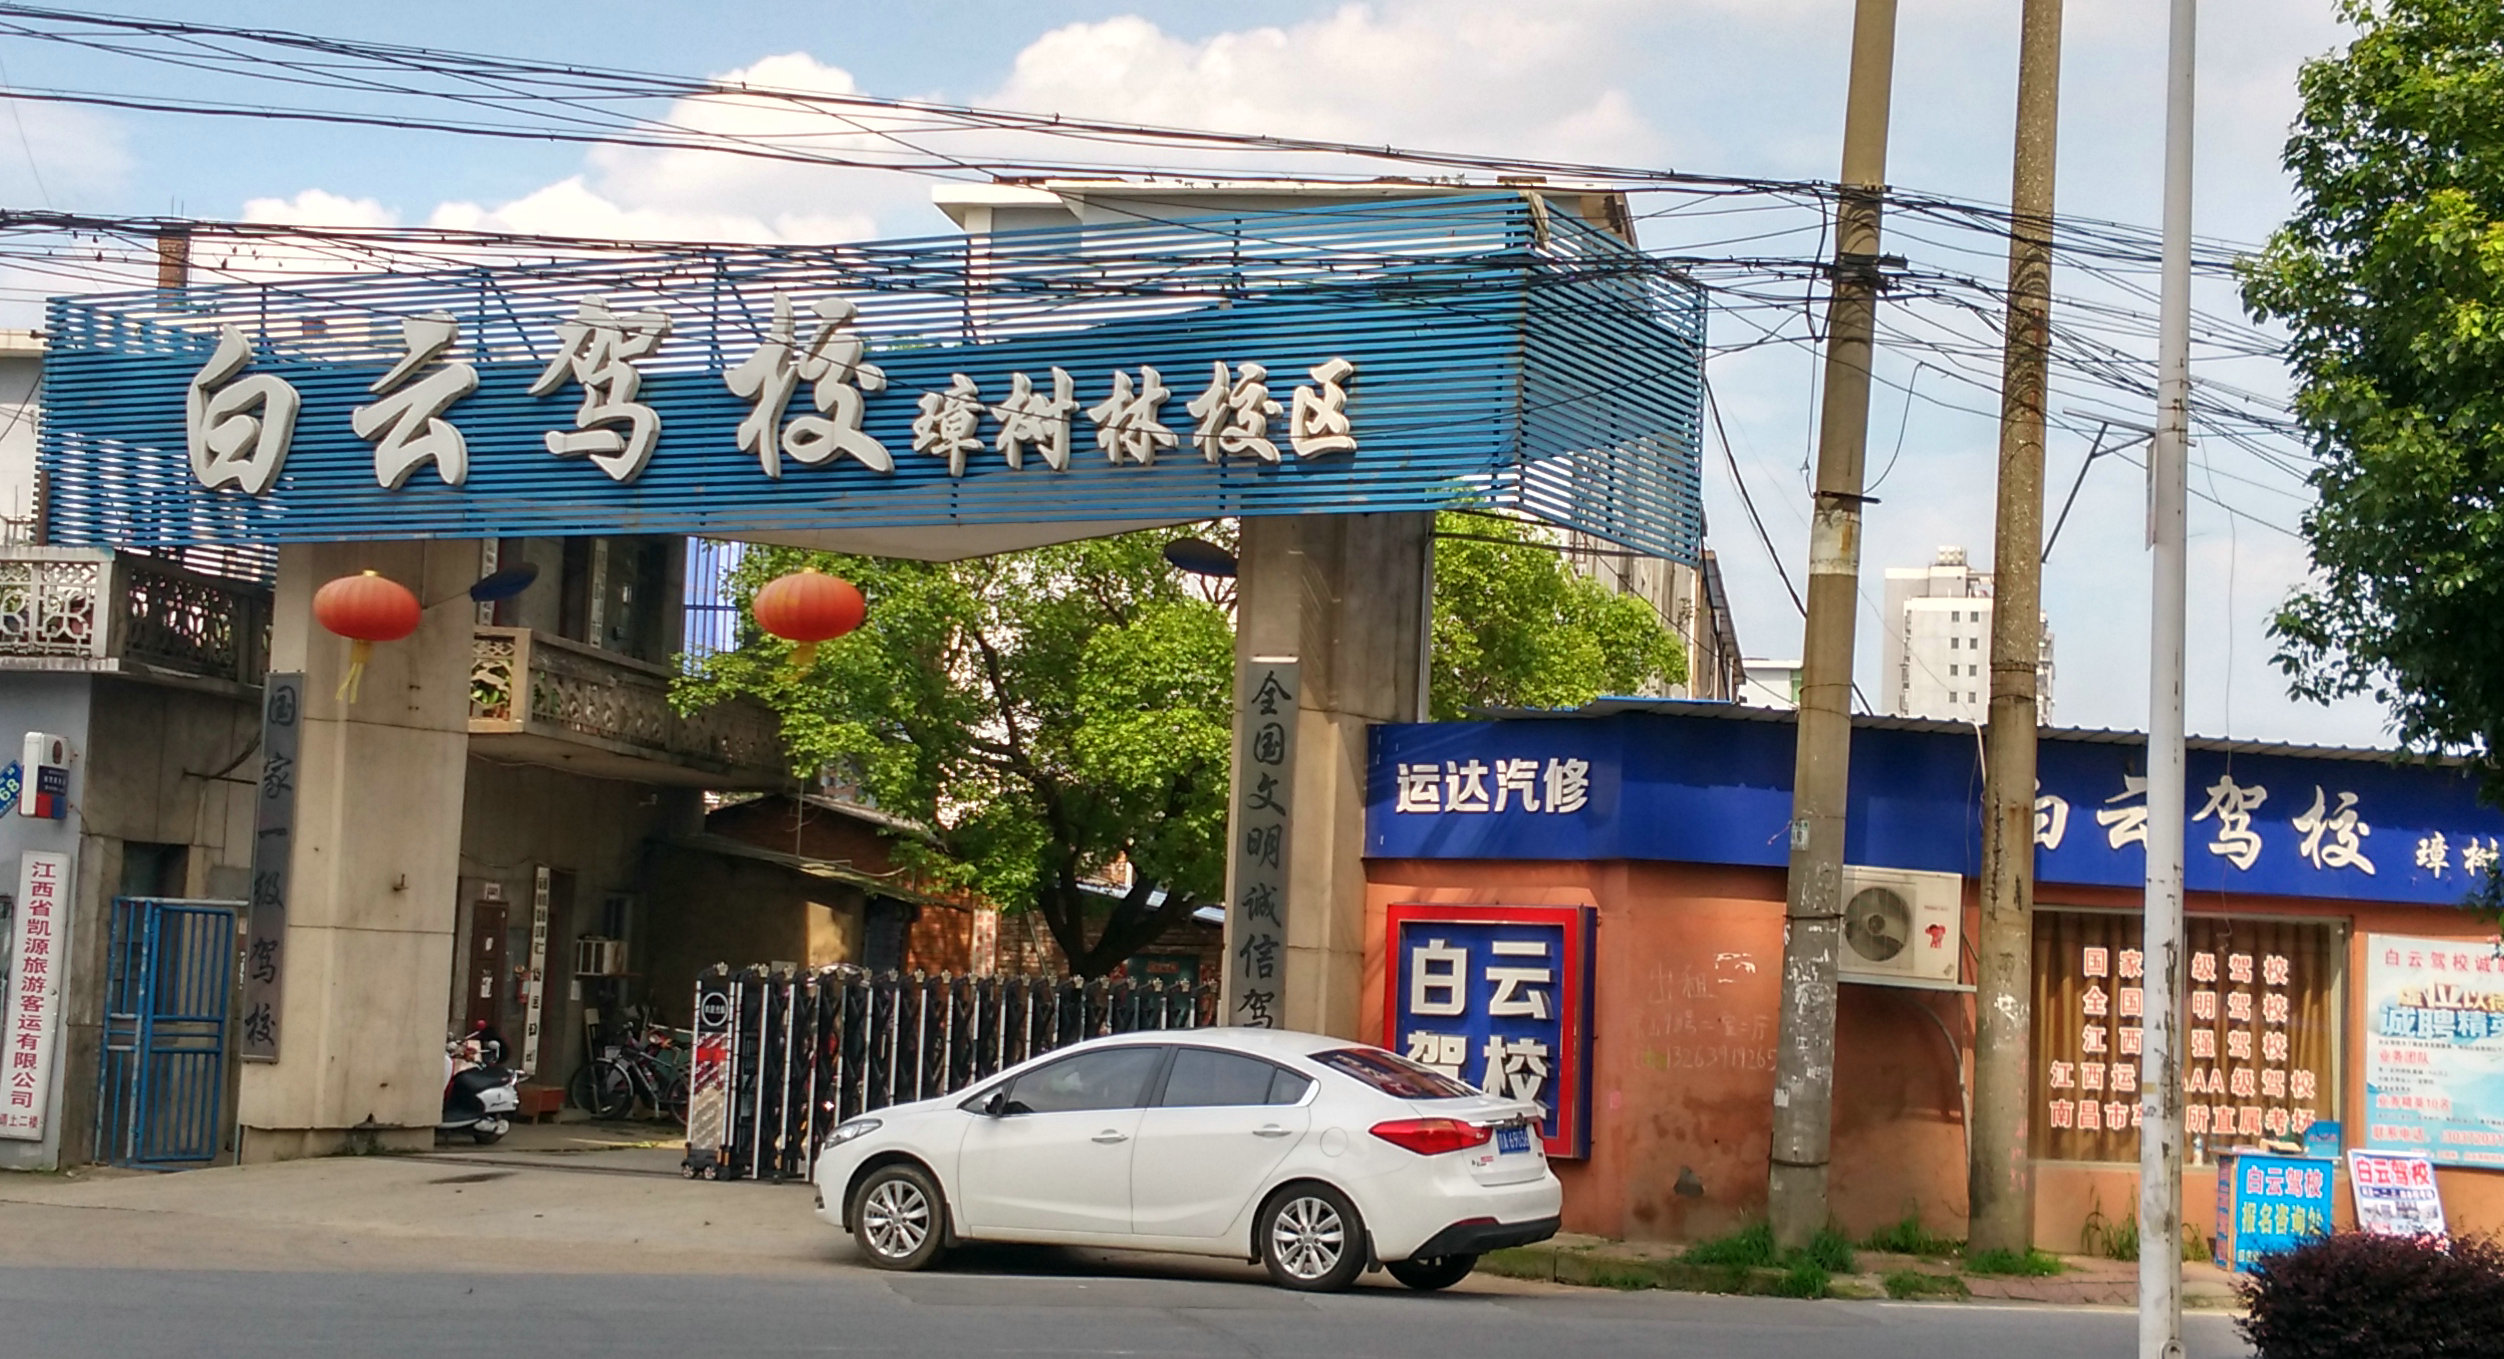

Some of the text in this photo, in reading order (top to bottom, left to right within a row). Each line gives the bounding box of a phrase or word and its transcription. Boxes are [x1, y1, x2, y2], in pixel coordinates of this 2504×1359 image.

[187, 291, 895, 495] 白云驾校
[1395, 757, 1590, 814] 运达汽修
[245, 685, 297, 1048] 国家一级驾校
[10, 861, 56, 1109] 江西省凯源旅游客运有限公司
[1410, 939, 1553, 1021] 白云
[2083, 947, 2289, 985] 国家级驾校
[2082, 986, 2288, 1023] 全国明驾校
[2082, 1024, 2288, 1061] 江西强驾校
[2246, 1165, 2323, 1198] 白云驾校
[2356, 1156, 2431, 1187] 白云驾校
